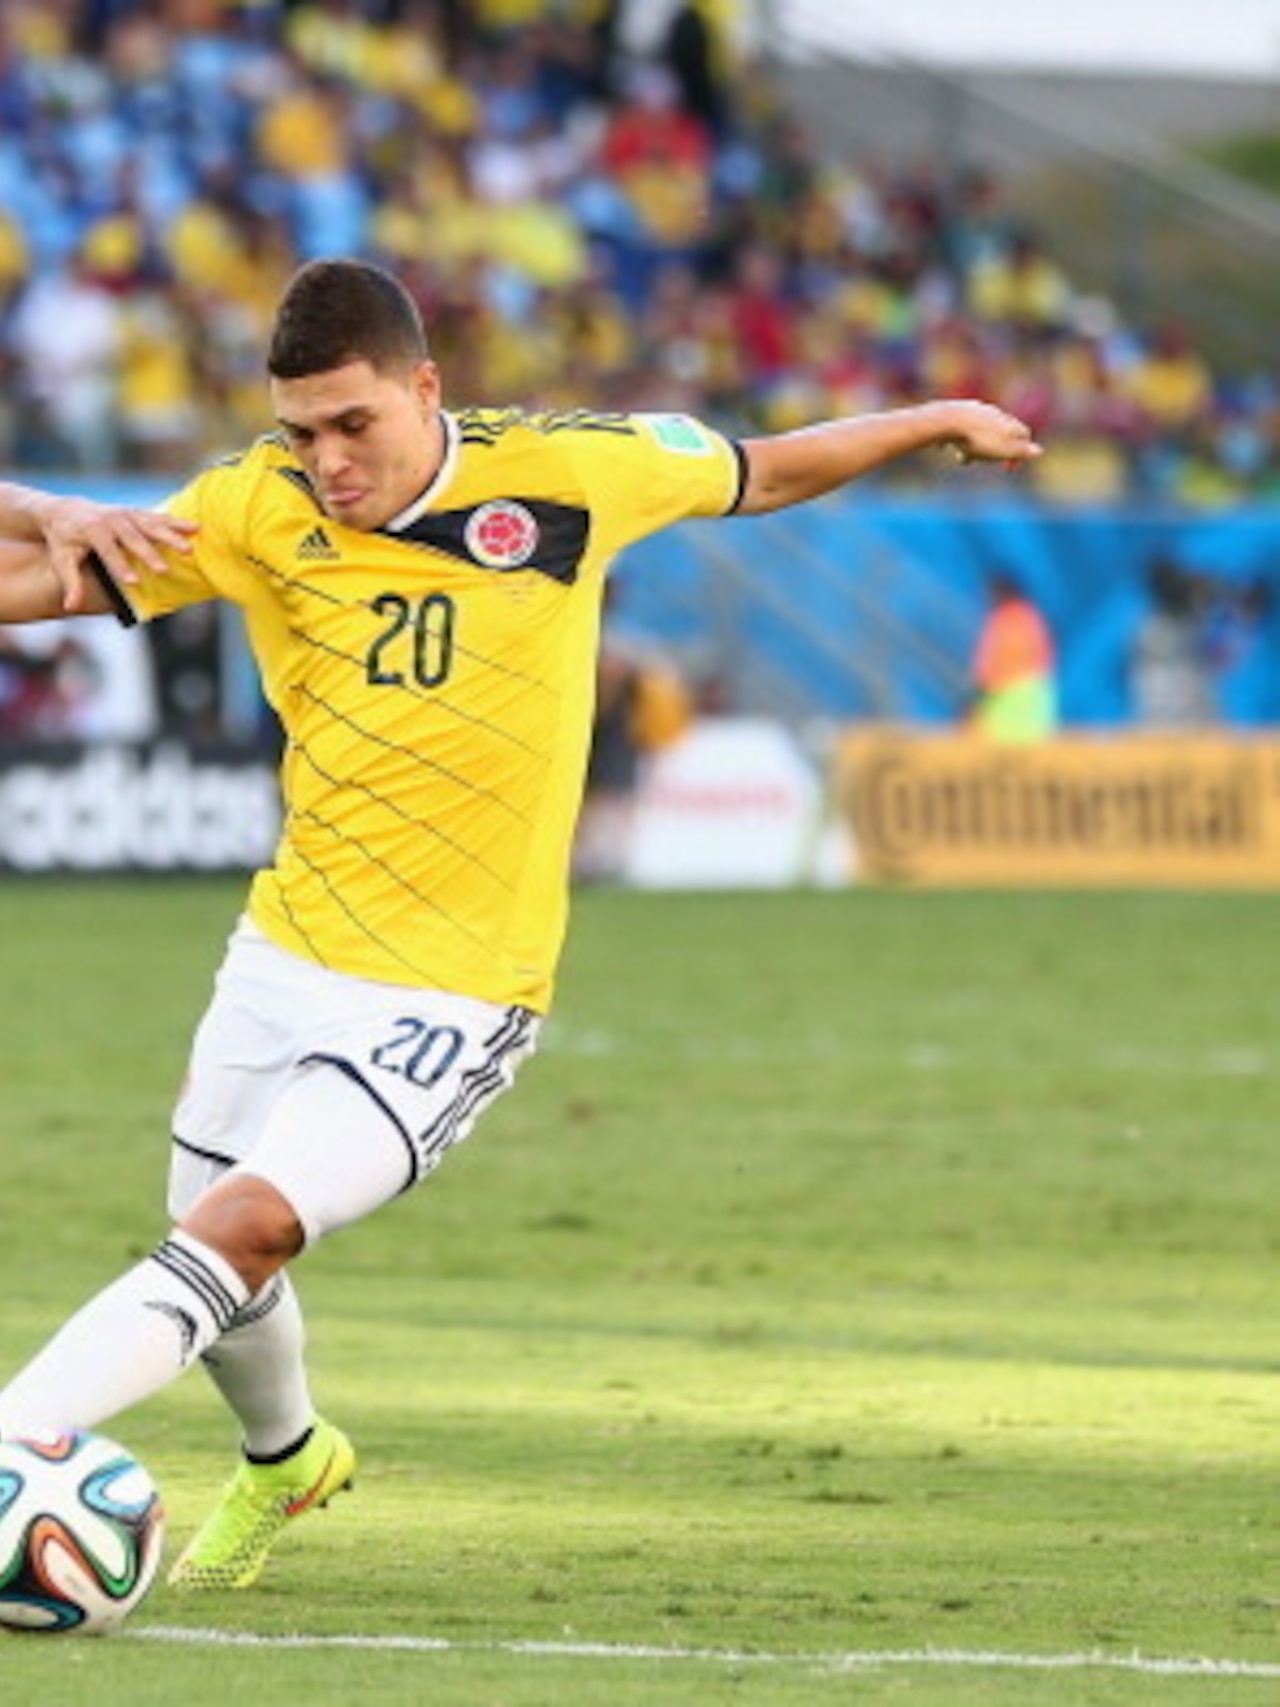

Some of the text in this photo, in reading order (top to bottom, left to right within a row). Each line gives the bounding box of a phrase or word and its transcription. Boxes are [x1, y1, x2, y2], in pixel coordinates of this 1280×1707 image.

[366, 591, 455, 689] 20
[848, 752, 1258, 882] Continental
[370, 1016, 465, 1091] 20
